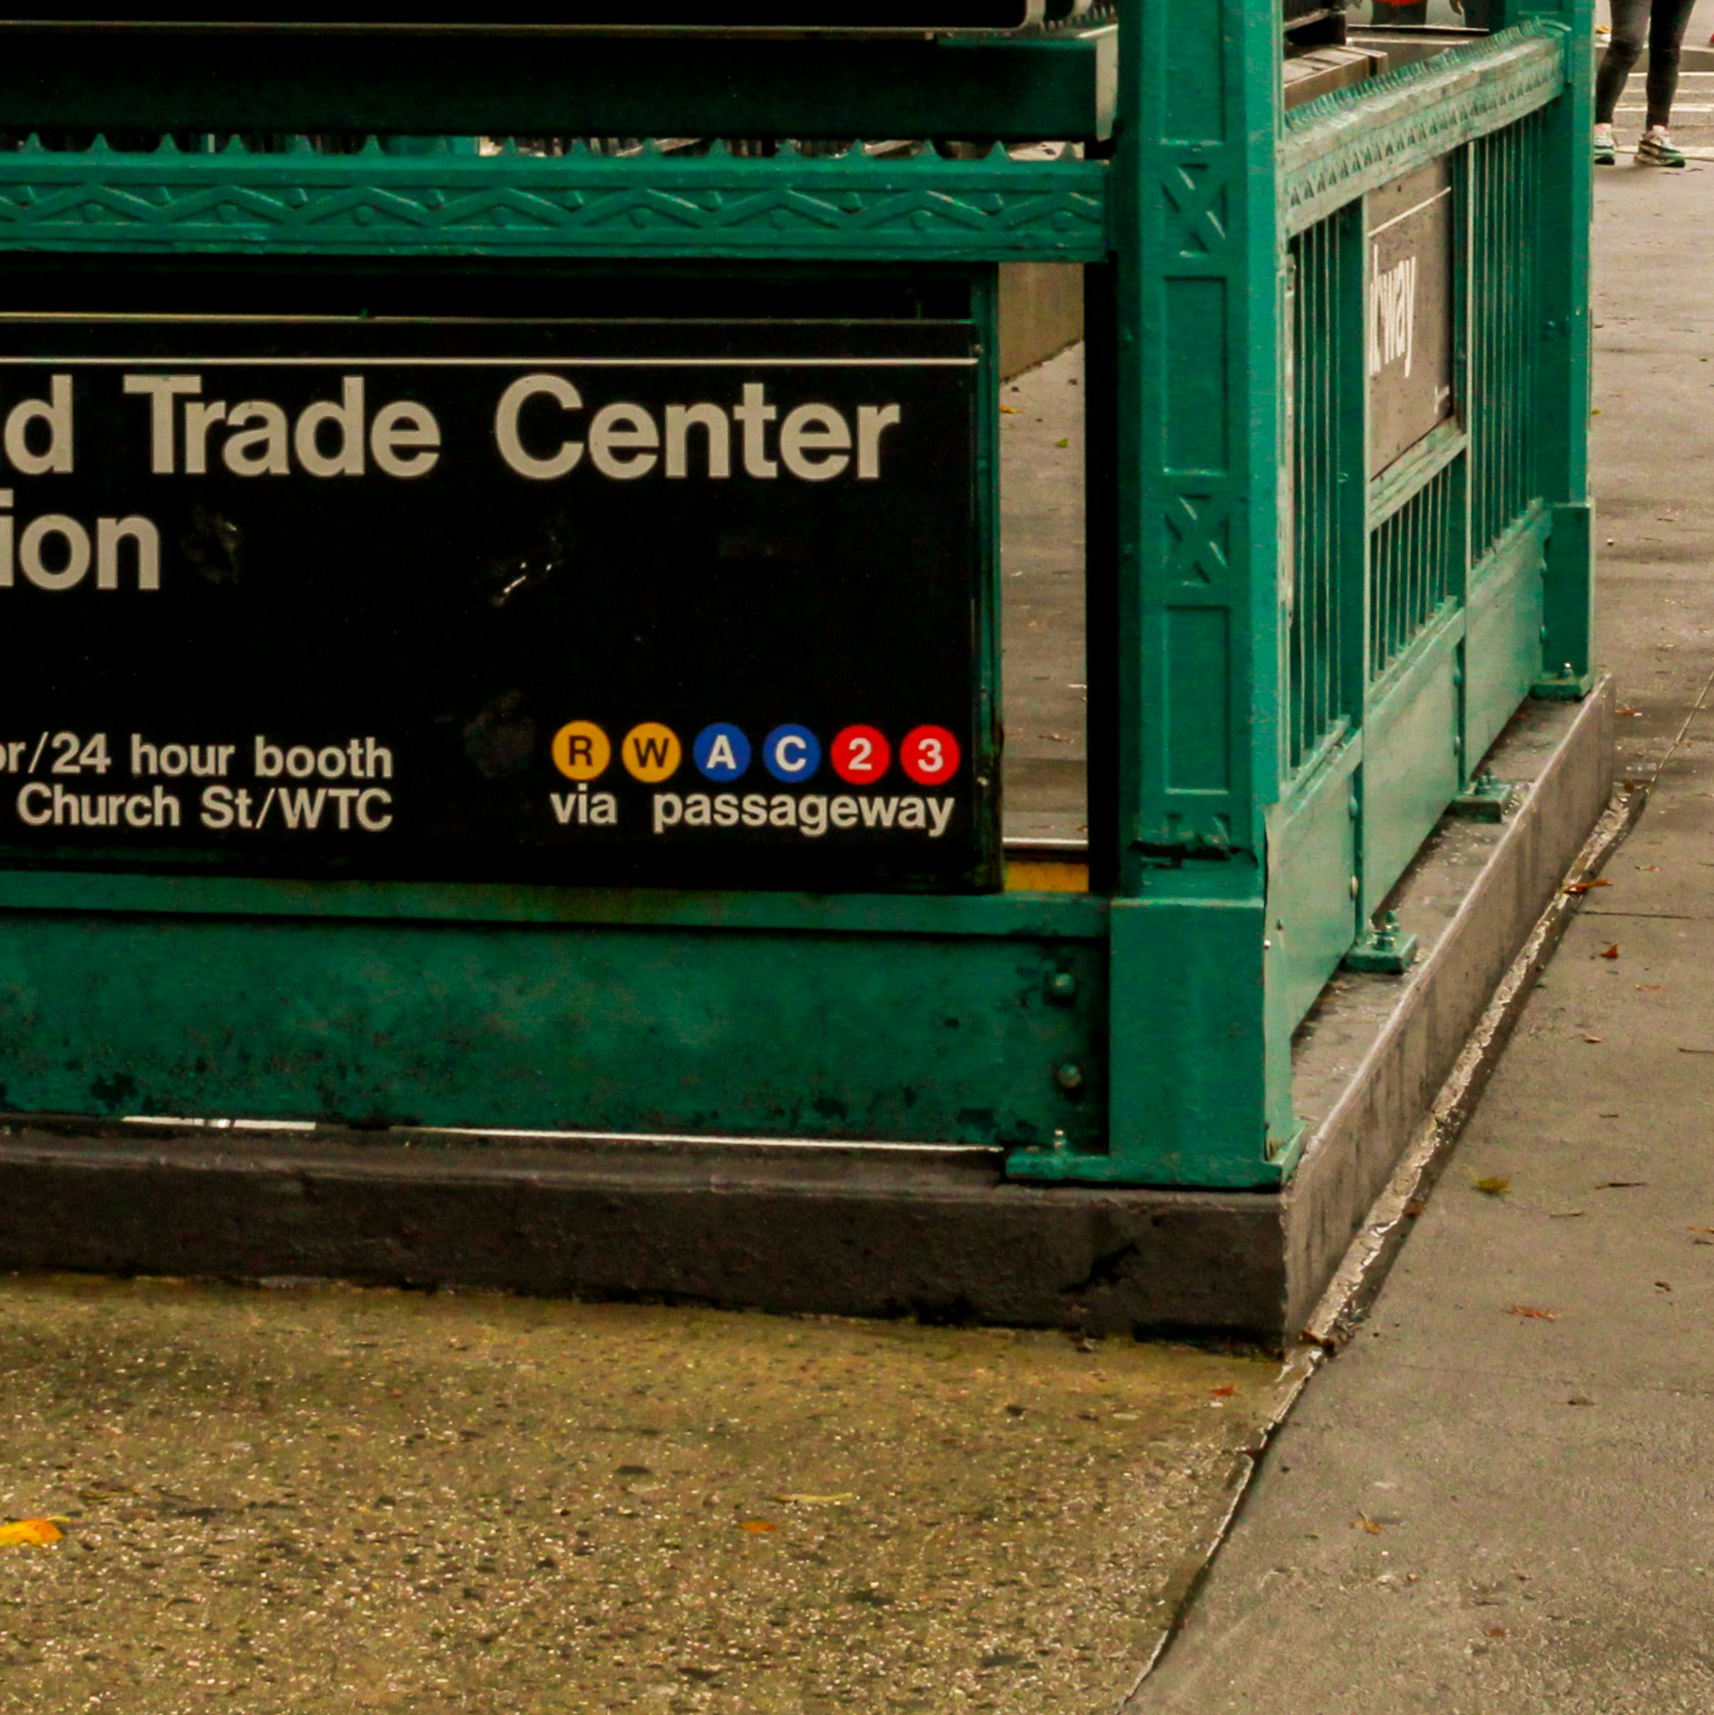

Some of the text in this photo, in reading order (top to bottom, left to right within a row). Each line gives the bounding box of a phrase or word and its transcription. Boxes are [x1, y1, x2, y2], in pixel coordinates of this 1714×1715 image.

[123, 375, 441, 478] Trade
[495, 374, 901, 481] Center
[130, 733, 236, 777] hour
[254, 735, 393, 779] booth
[569, 734, 944, 773] R W A C 2 3
[17, 782, 181, 827] Church
[200, 784, 393, 831] St/WTC
[549, 783, 956, 838] via passageway
